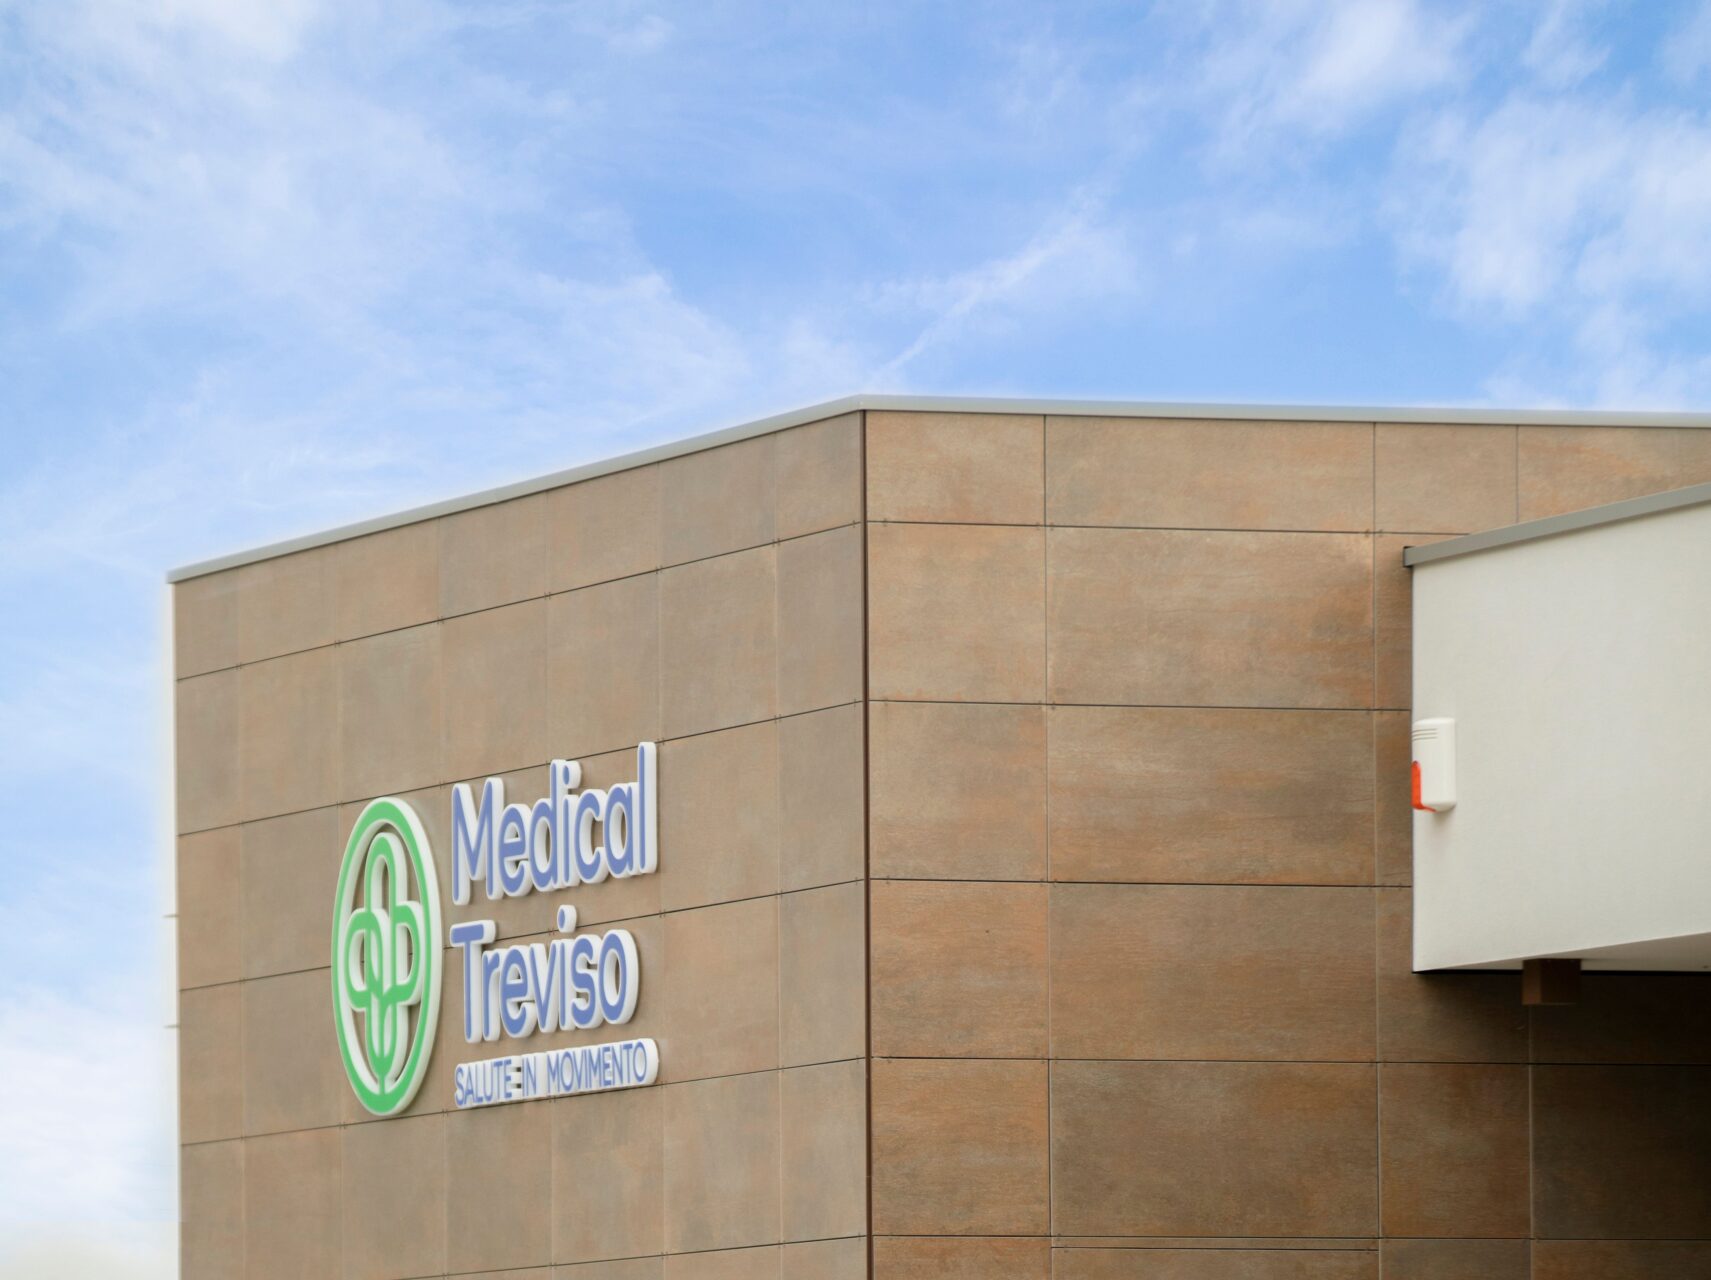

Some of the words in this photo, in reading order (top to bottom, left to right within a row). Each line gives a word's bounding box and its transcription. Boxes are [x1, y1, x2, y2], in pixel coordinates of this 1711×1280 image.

[452, 742, 653, 904] Medical
[450, 906, 634, 1042] Treviso
[455, 1058, 513, 1106] SALUTE
[521, 1054, 537, 1097] IN
[547, 1041, 648, 1094] MOVIMENTO
